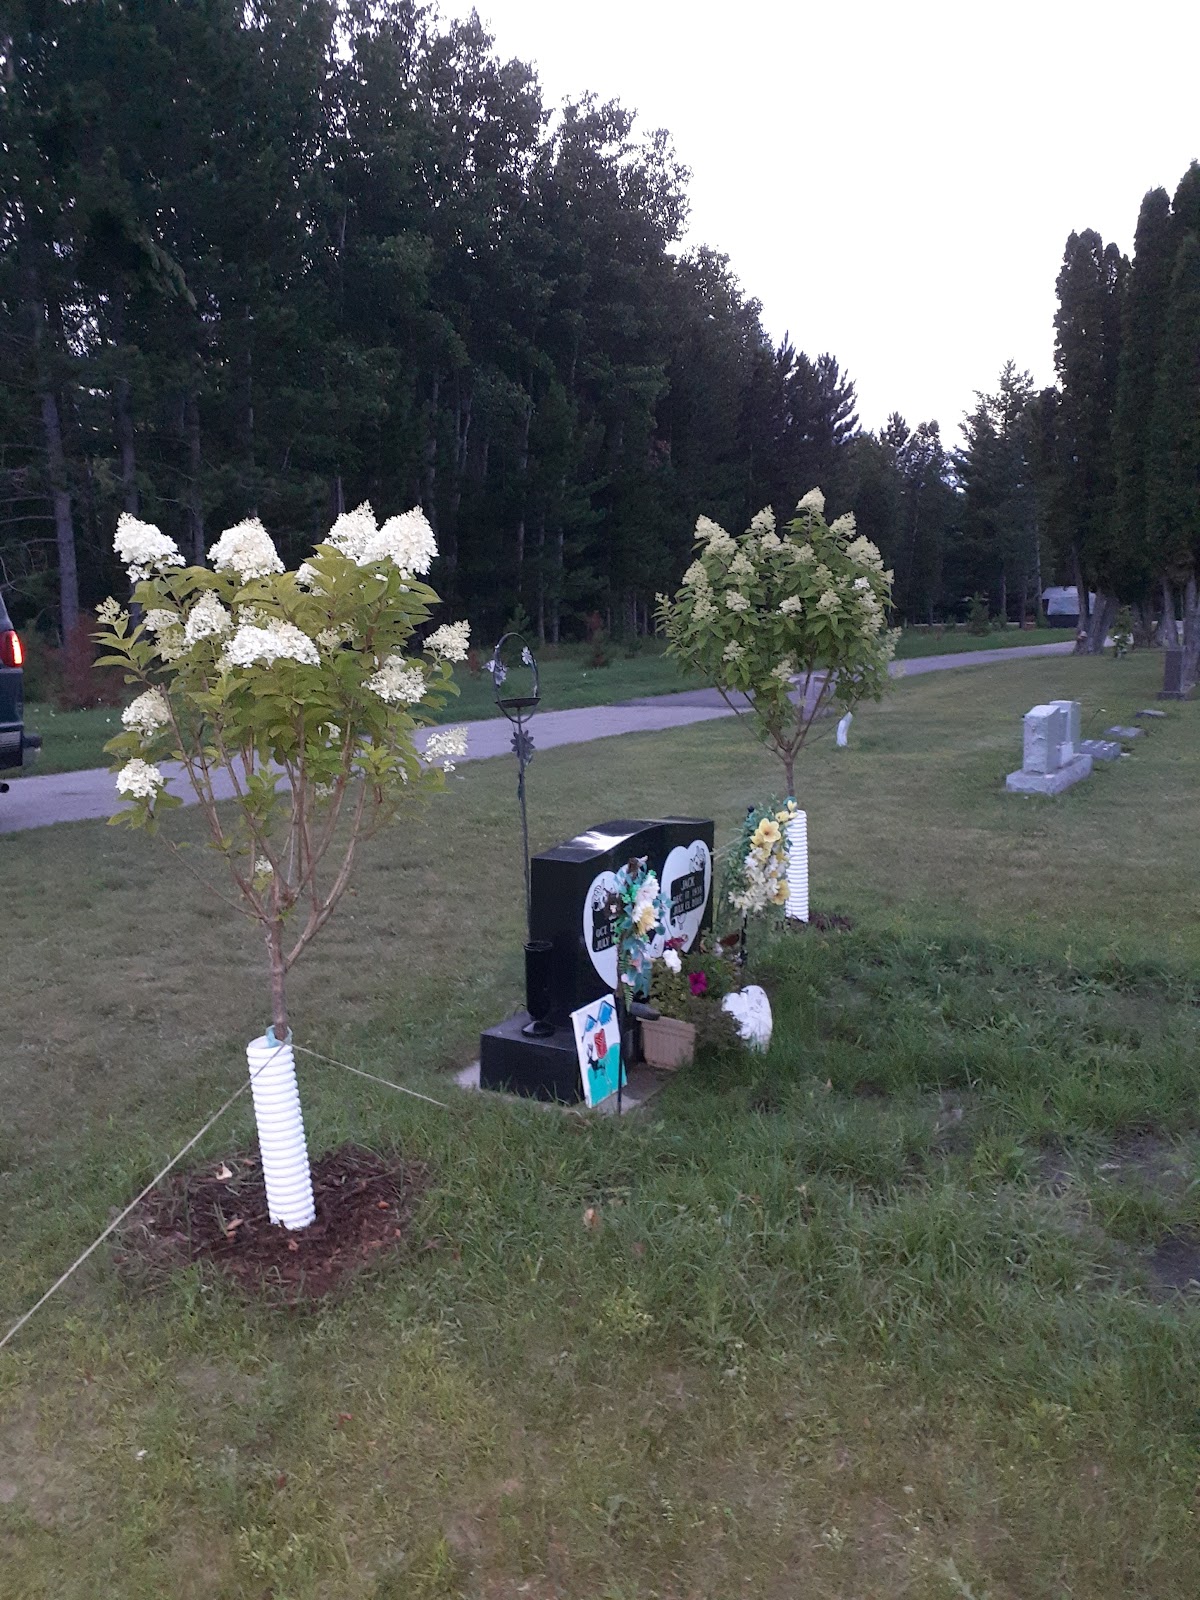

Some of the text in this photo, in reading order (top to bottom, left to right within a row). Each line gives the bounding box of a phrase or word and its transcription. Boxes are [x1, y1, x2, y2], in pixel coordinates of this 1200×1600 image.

[681, 876, 695, 891] JACK
[595, 925, 608, 938] OCT
[595, 936, 611, 951] JULY
